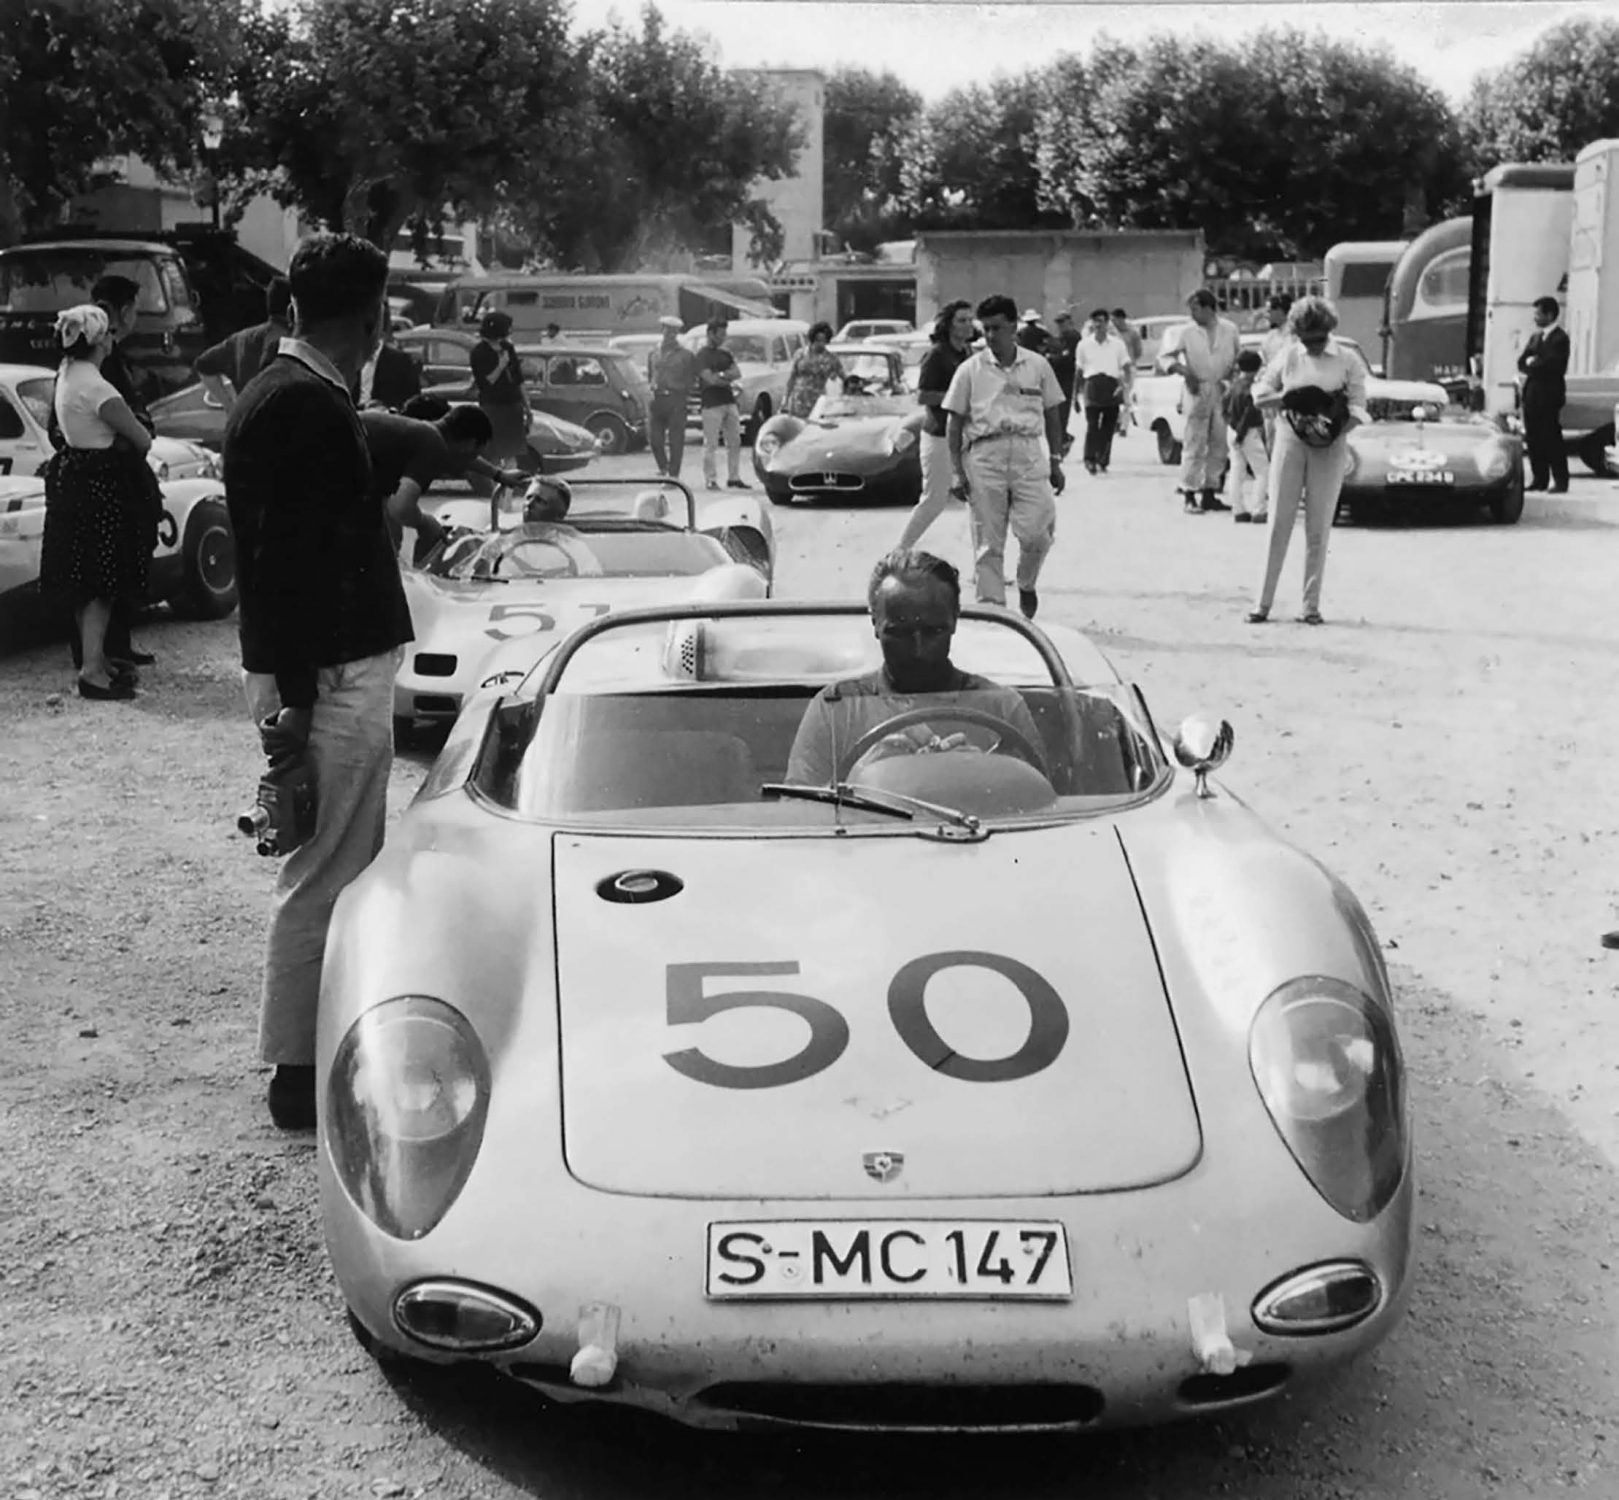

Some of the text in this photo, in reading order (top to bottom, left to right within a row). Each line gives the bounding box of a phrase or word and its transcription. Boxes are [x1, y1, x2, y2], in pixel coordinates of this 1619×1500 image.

[662, 950, 1070, 1090] 50
[717, 1230, 1058, 1285] S-MC 147
